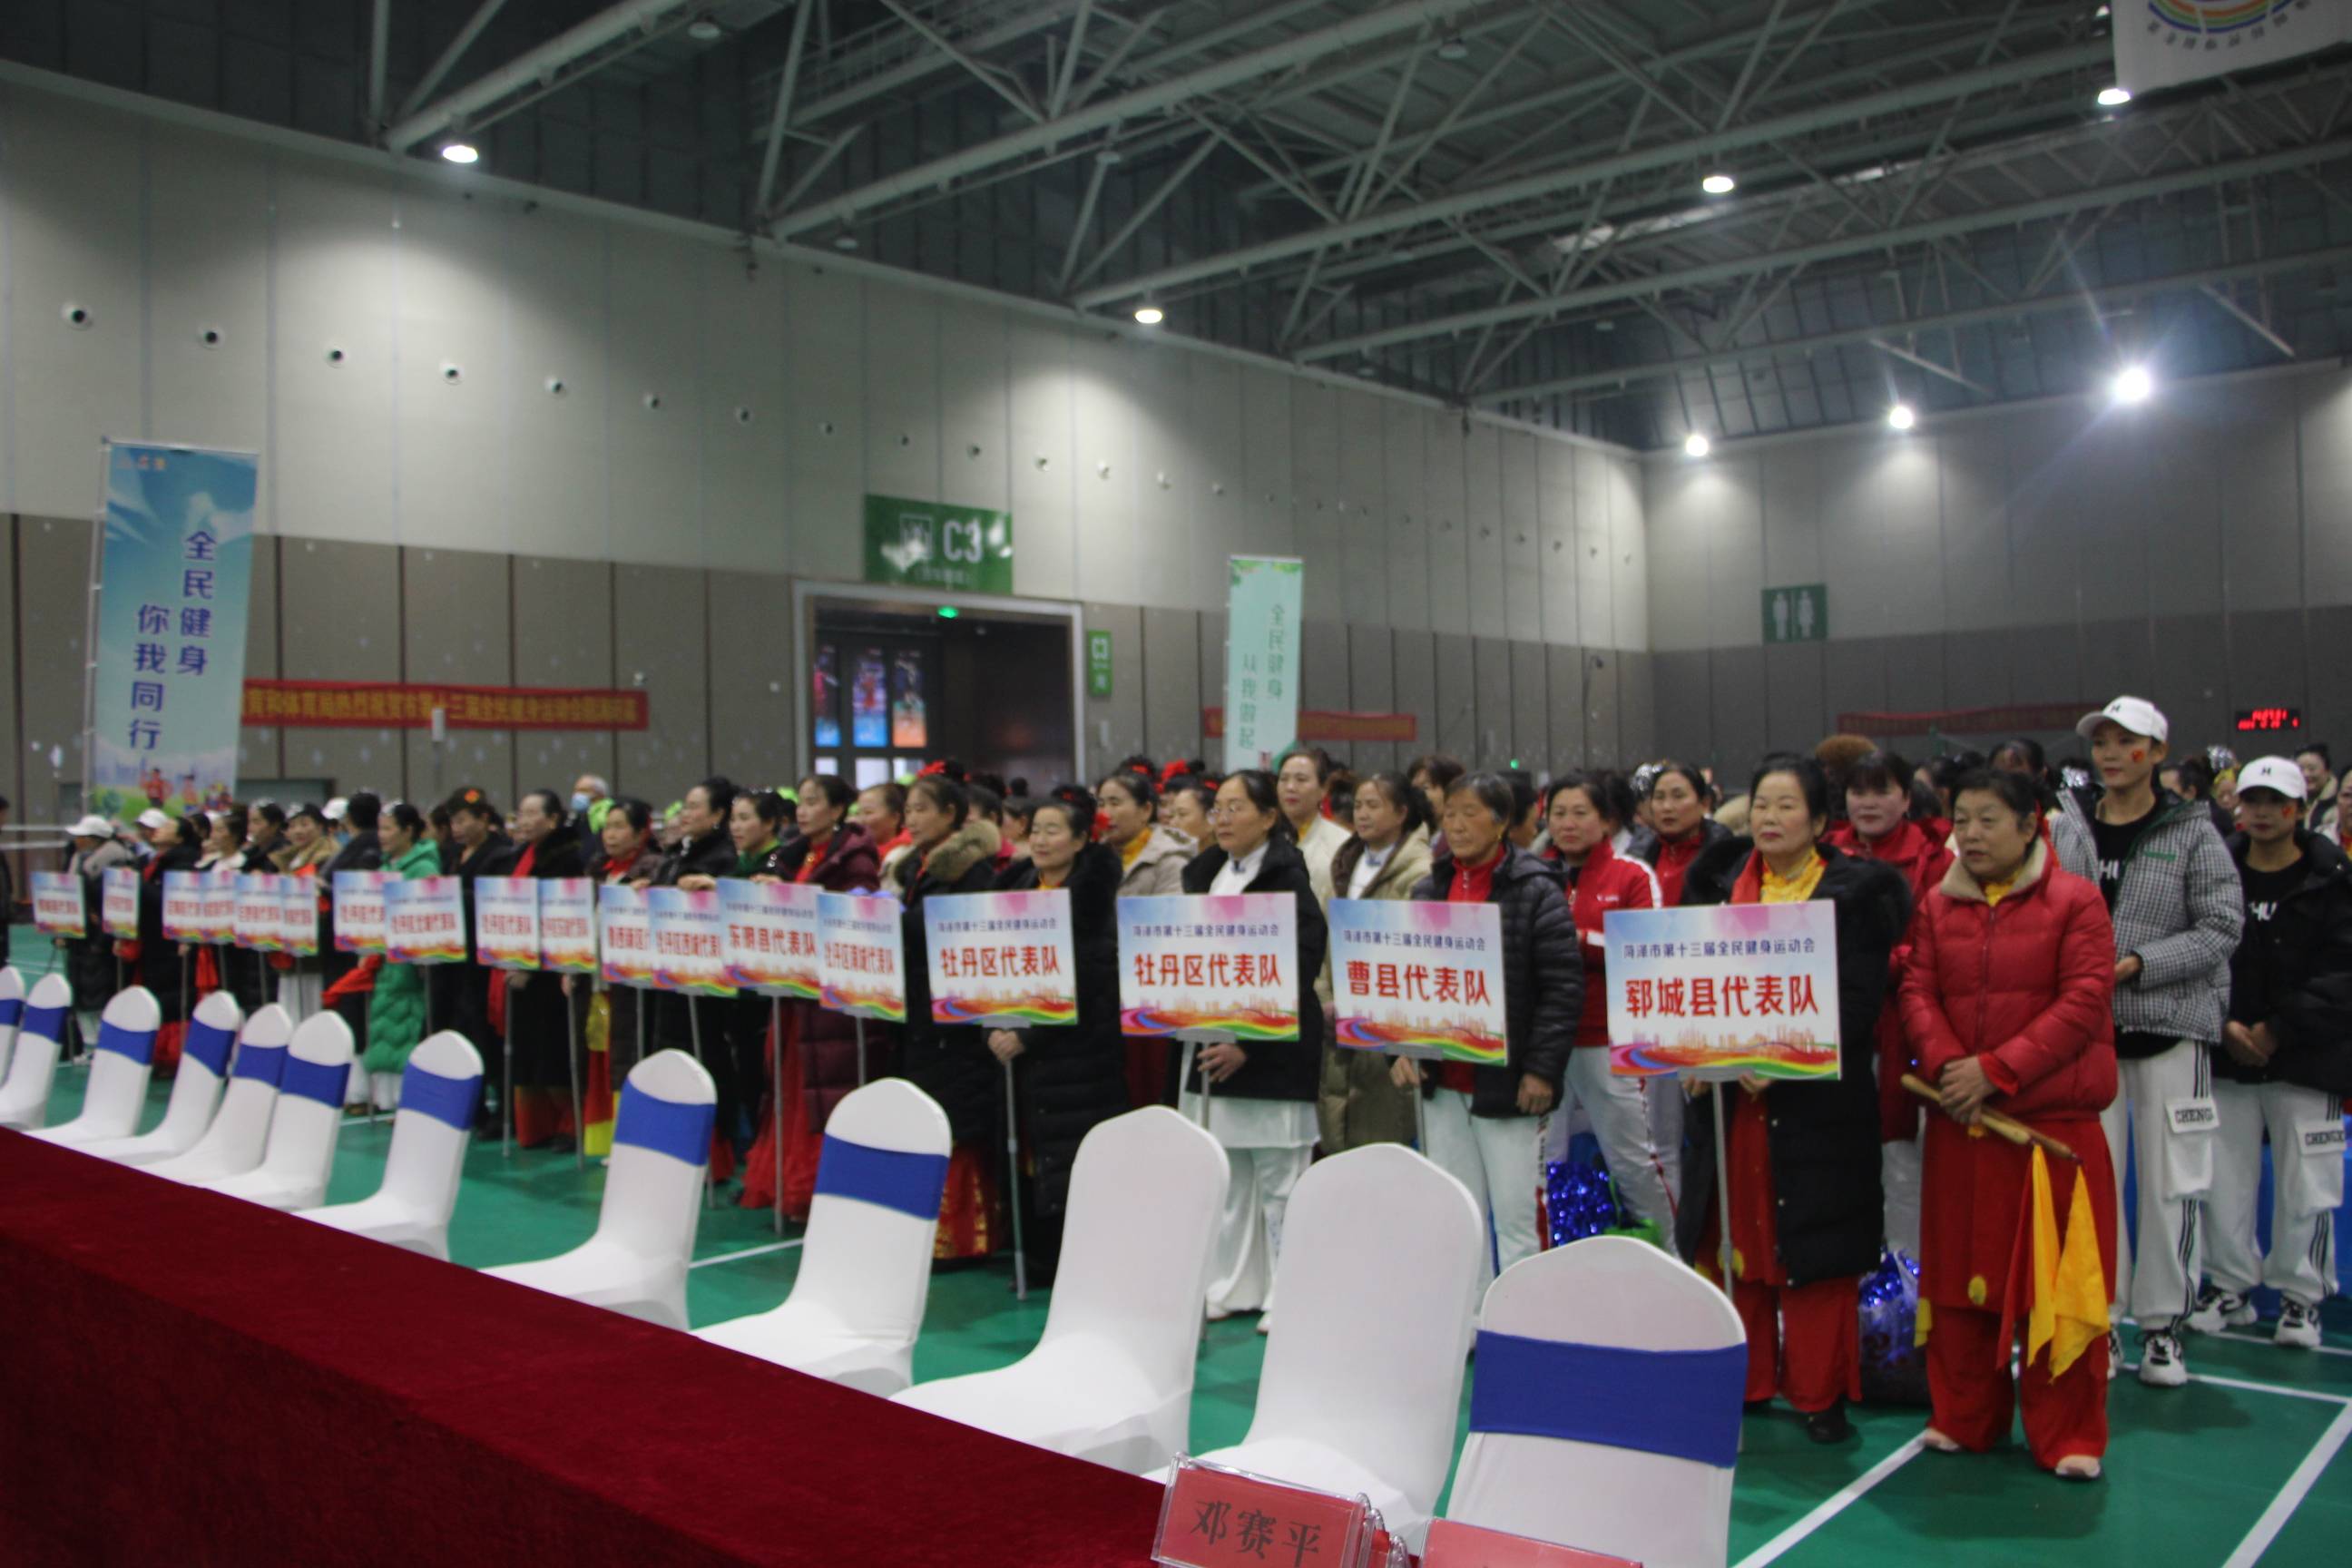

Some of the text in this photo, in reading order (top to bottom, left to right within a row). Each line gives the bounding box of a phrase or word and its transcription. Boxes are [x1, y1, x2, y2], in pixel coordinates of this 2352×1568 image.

[943, 519, 983, 564] C3
[177, 531, 217, 676] 全民健身
[1269, 603, 1285, 701] 全民健身
[129, 603, 170, 750] 你我同行
[940, 945, 1061, 978] 牡丹区代表队
[1343, 929, 1487, 952] 菏泽市第十三届全民健身运动会
[1624, 939, 1816, 960] 菏泽市第十三届全民健身运动会
[1134, 952, 1280, 989] 牡丹区代表队
[1347, 959, 1491, 1006] 曹县代表队
[1625, 975, 1820, 1019] 郓城县代表队
[1190, 1500, 1323, 1568] 邓赛平
